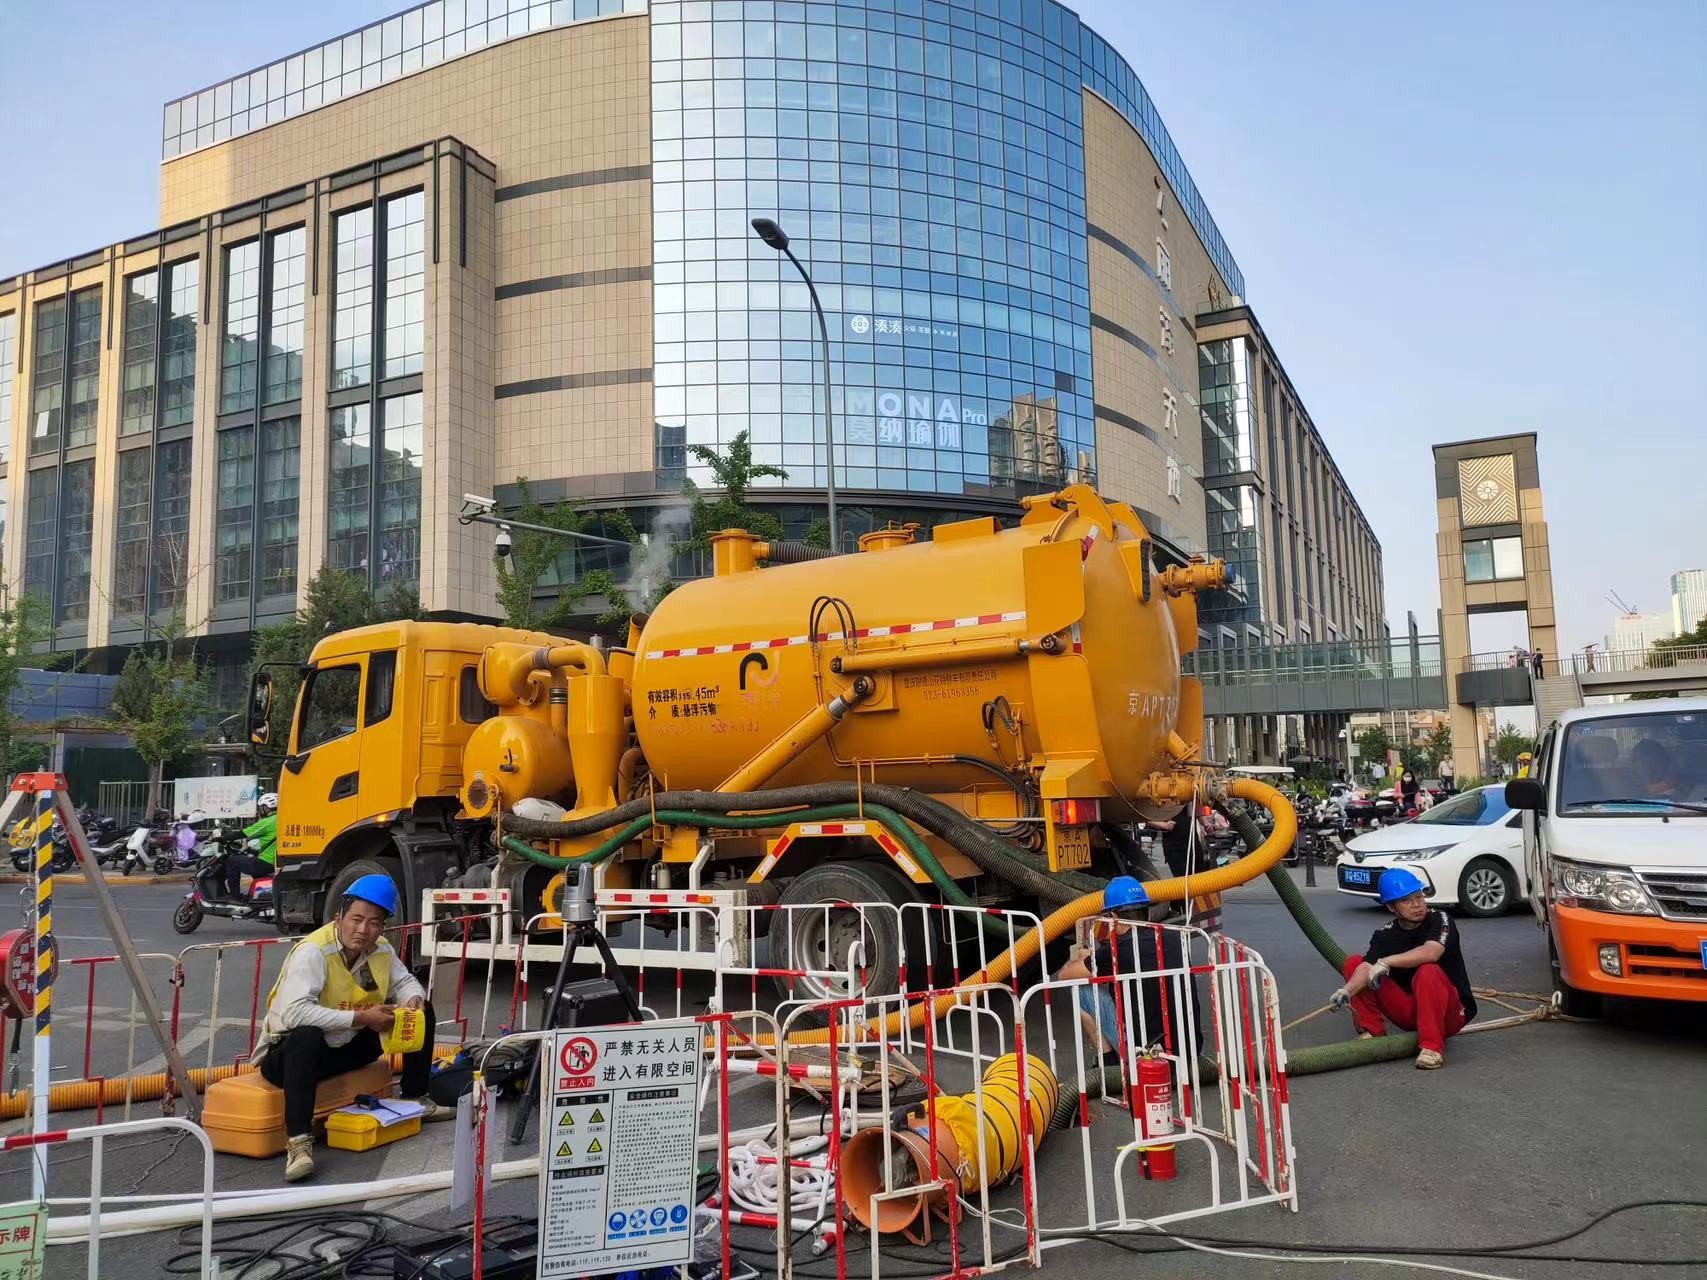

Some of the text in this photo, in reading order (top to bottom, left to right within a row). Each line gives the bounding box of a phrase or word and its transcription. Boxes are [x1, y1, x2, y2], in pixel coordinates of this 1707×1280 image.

[962, 408, 987, 426] Pro
[1057, 843, 1090, 868] PT702
[603, 1036, 697, 1058] 严禁无关人员
[602, 1060, 696, 1082] 进入有限空间
[560, 1077, 595, 1088] 禁止入内
